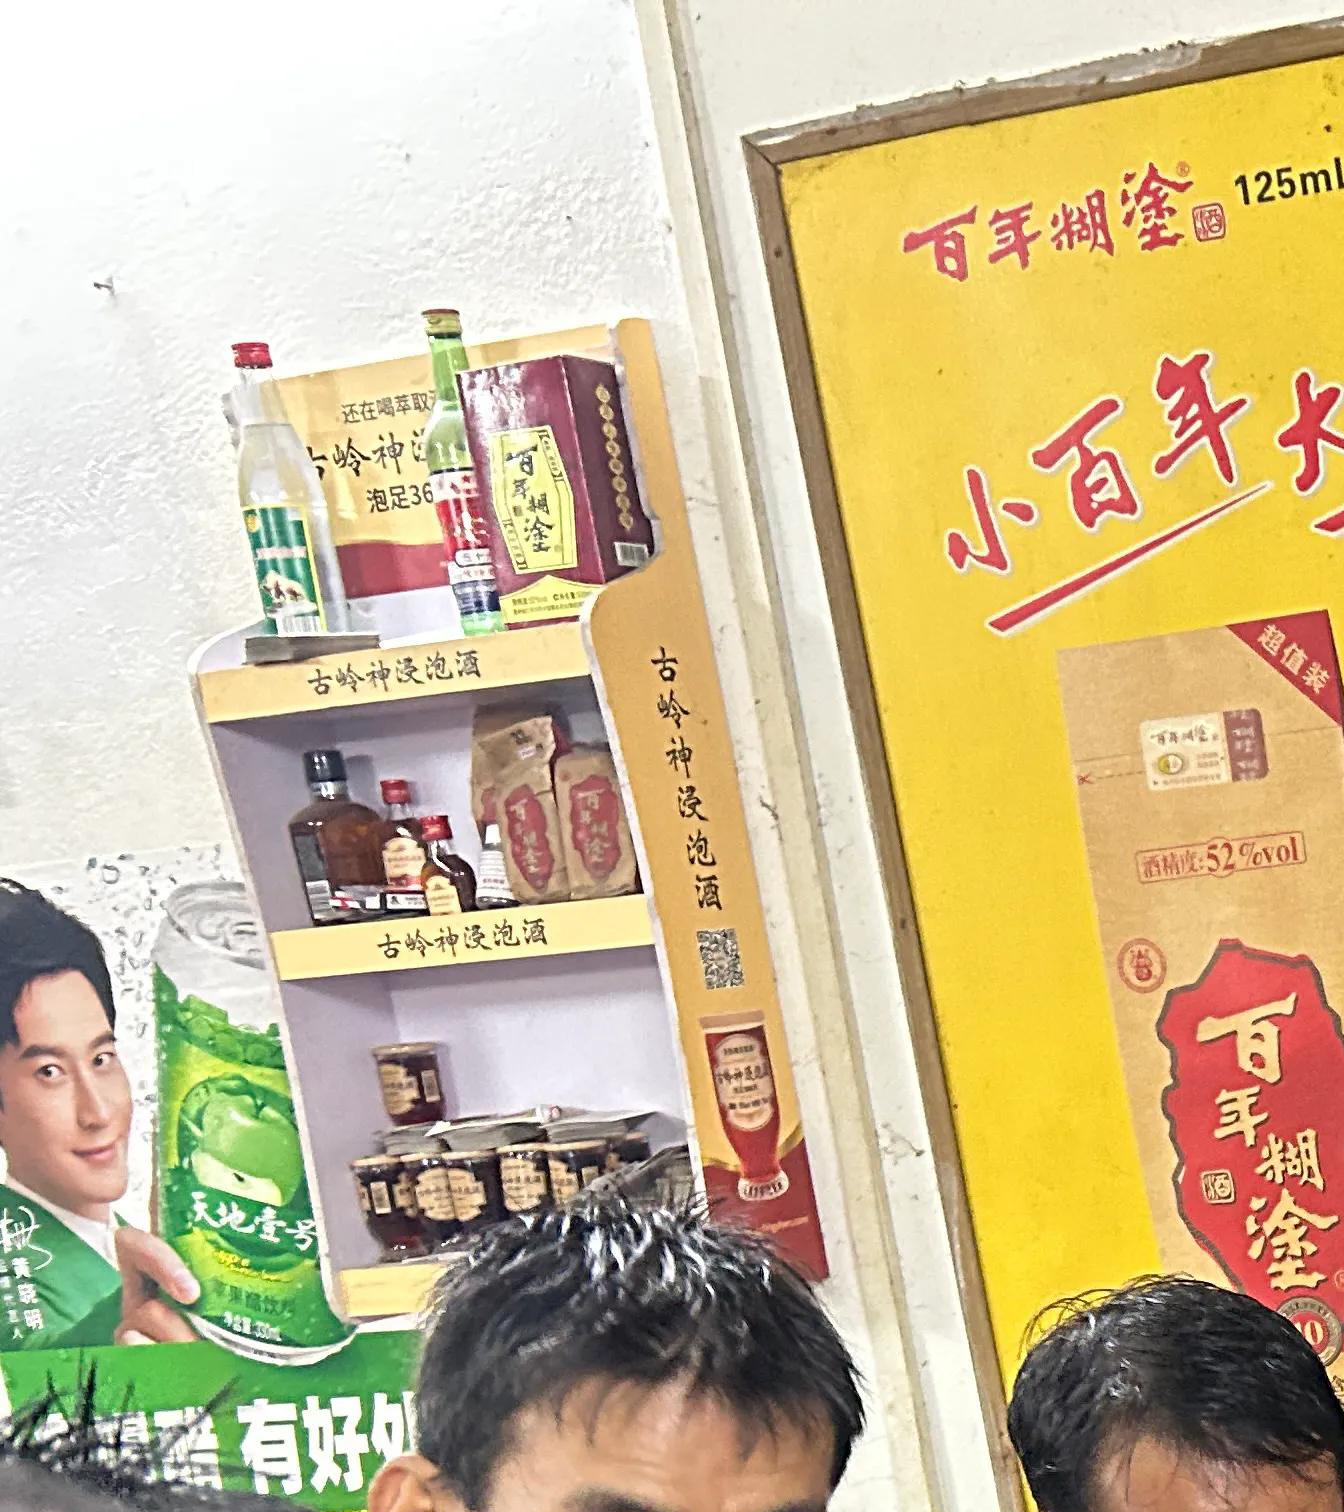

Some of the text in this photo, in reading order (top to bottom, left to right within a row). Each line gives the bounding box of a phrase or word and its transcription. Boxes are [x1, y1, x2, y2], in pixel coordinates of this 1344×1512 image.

[306, 648, 482, 696] 古岭神浸泡酒
[1257, 623, 1331, 695] 超值装
[650, 645, 724, 912] 古岭神浸泡酒
[376, 917, 549, 961] 古岭神浸泡酒
